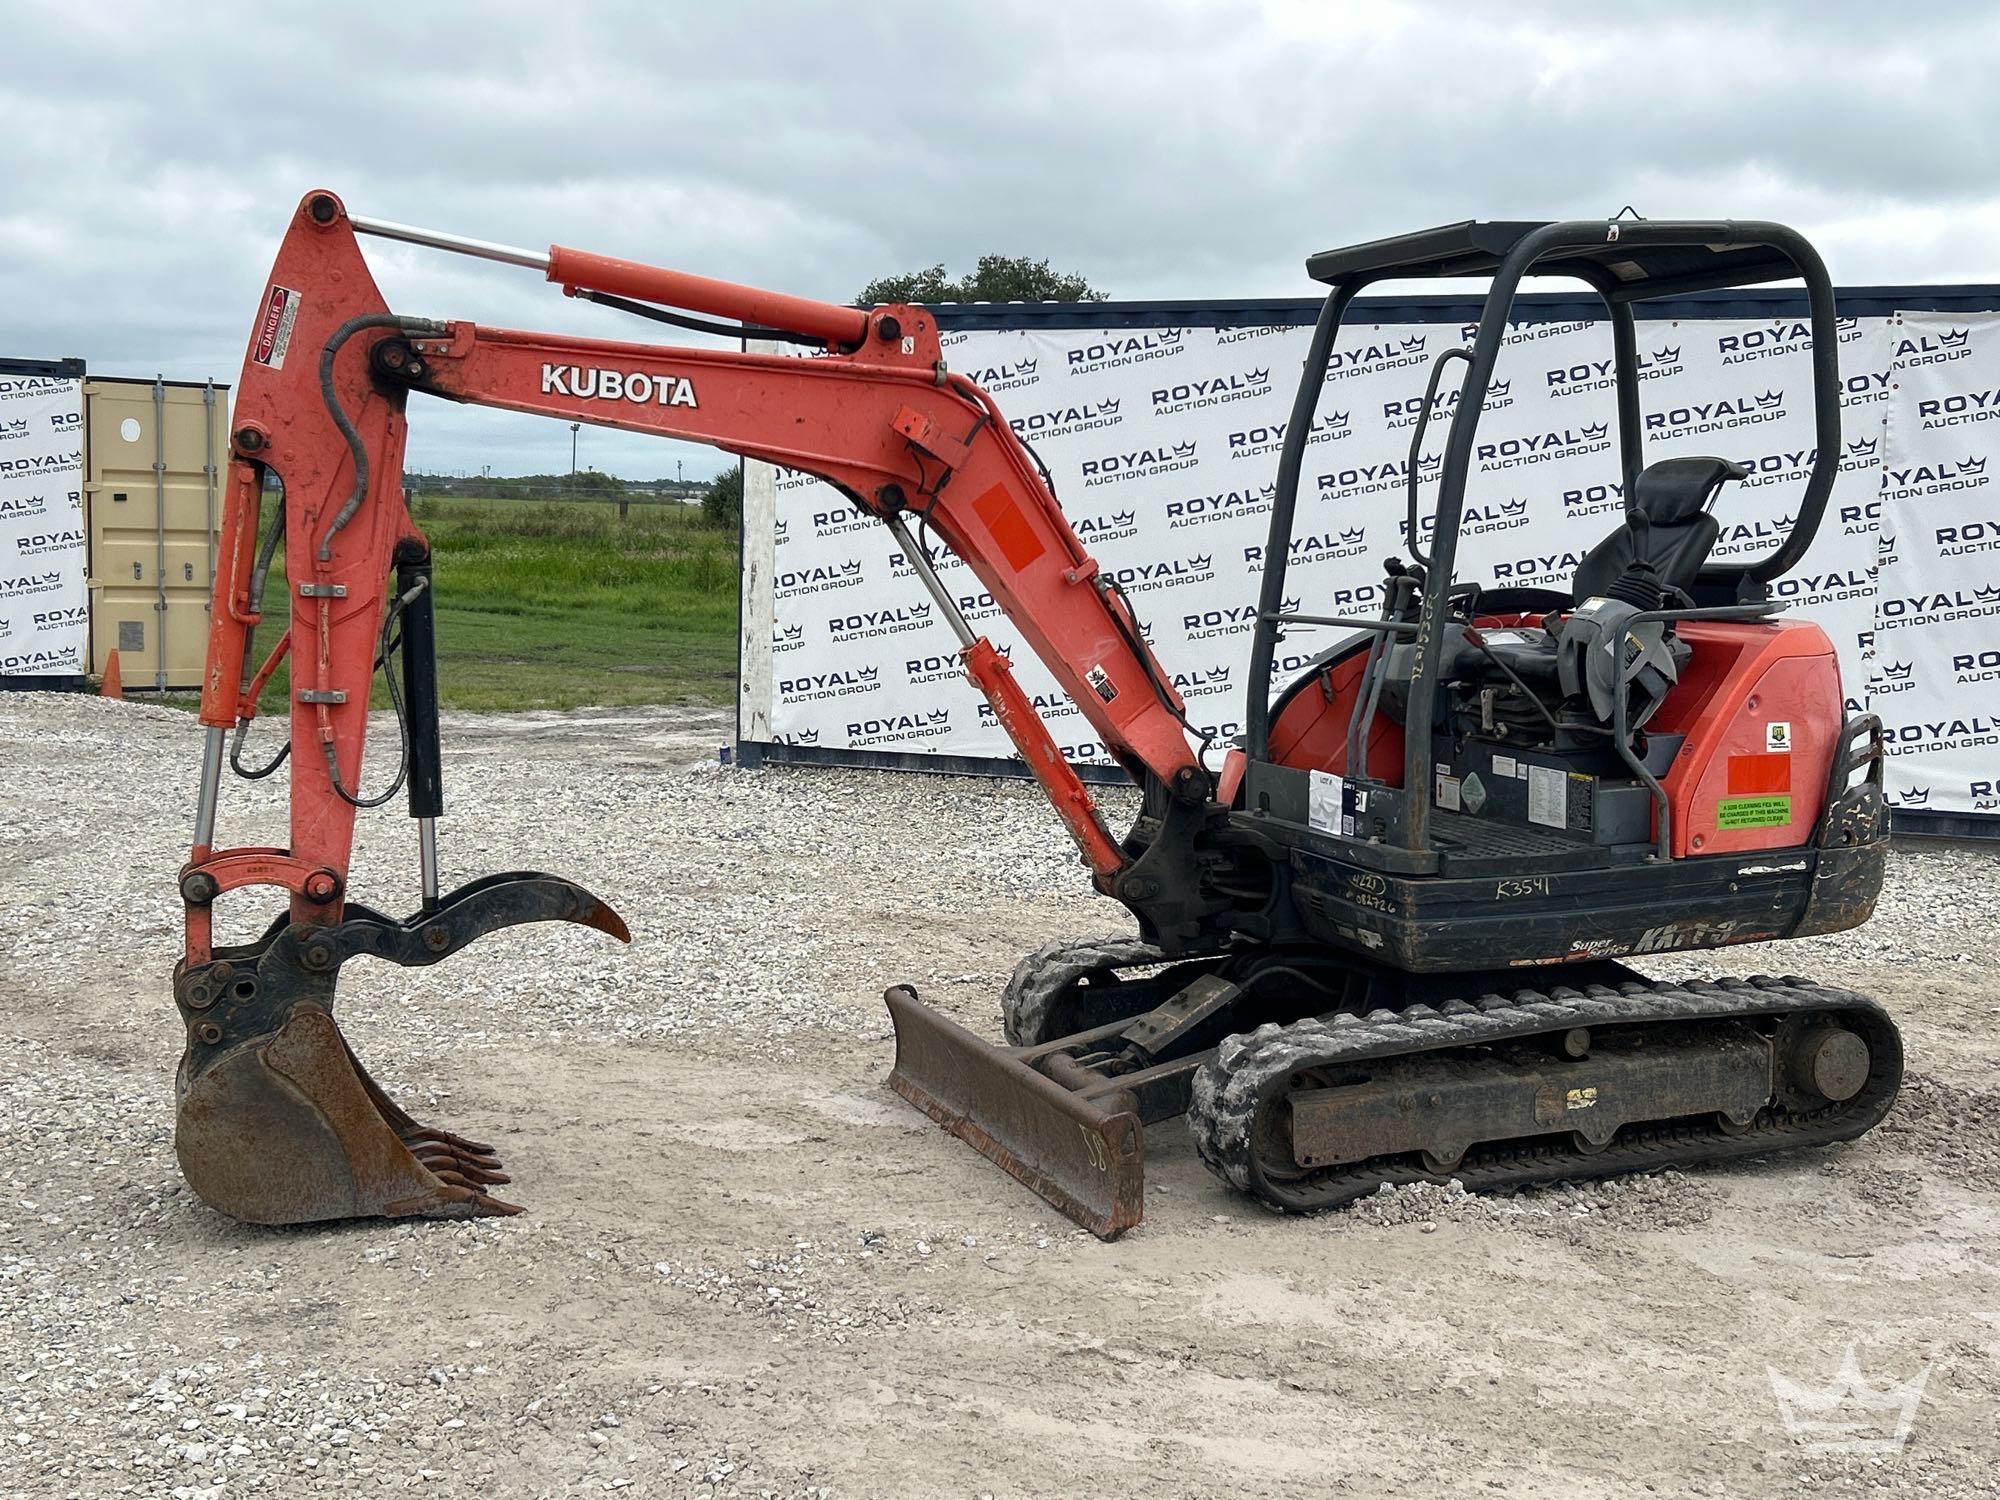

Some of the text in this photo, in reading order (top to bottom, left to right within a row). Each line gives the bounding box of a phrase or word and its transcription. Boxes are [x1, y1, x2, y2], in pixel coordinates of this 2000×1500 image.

[263, 306, 281, 347] DANGER
[1067, 335, 1157, 365] ROYAL
[1722, 344, 1797, 365] AUCTION
[1909, 349, 1972, 367] GROUP
[1070, 345, 1184, 376] AUCTION GROUP
[1375, 354, 1429, 372] GROUP
[0, 378, 53, 392] OYAL
[1, 386, 73, 400] CTION GROUP
[541, 363, 699, 408] KUBOTA
[993, 376, 1040, 393] GROUP
[1152, 375, 1245, 405] ROYAL
[1155, 386, 1272, 416] AUCTION GROUP
[1646, 398, 1754, 430] ROYAL
[1074, 416, 1123, 432] GROUP
[1649, 410, 1786, 442] AUCTION GROUP
[1477, 430, 1581, 461] ROYAL
[0, 454, 70, 471] ROYAL
[1082, 448, 1172, 476] ROYAL
[1480, 442, 1611, 473] AUCTION GROUP
[3, 463, 82, 480] AUCTION GROU
[1084, 459, 1199, 488] AUCTION GROUP
[1321, 482, 1388, 502] AUCTION
[1927, 477, 1989, 494] GROUP
[9, 507, 47, 518] GROUP
[1166, 490, 1260, 518] ROYAL
[1169, 511, 1233, 529] AUCTION
[1474, 518, 1530, 535] GROUP
[816, 521, 871, 538] AUCTION
[1089, 528, 1138, 544] GROUP
[20, 543, 67, 556] AUCTION
[1316, 545, 1367, 561] GROUP
[26, 583, 63, 595] GROUP
[822, 577, 864, 592] GROUP
[1165, 572, 1215, 588] GROUP
[829, 608, 910, 633] ROYAL
[832, 619, 934, 643] AUCTION GROUP
[1187, 624, 1250, 641] AUCTION
[42, 658, 79, 669] GROUP
[780, 671, 858, 695] ROYAL
[1182, 684, 1233, 698] GROUP
[782, 683, 881, 705] AUCTION GROUP
[847, 714, 927, 737] ROYAL
[850, 725, 952, 748] AUCTION GROUP
[1496, 877, 1549, 900] K3541
[1570, 938, 1613, 951] Super
